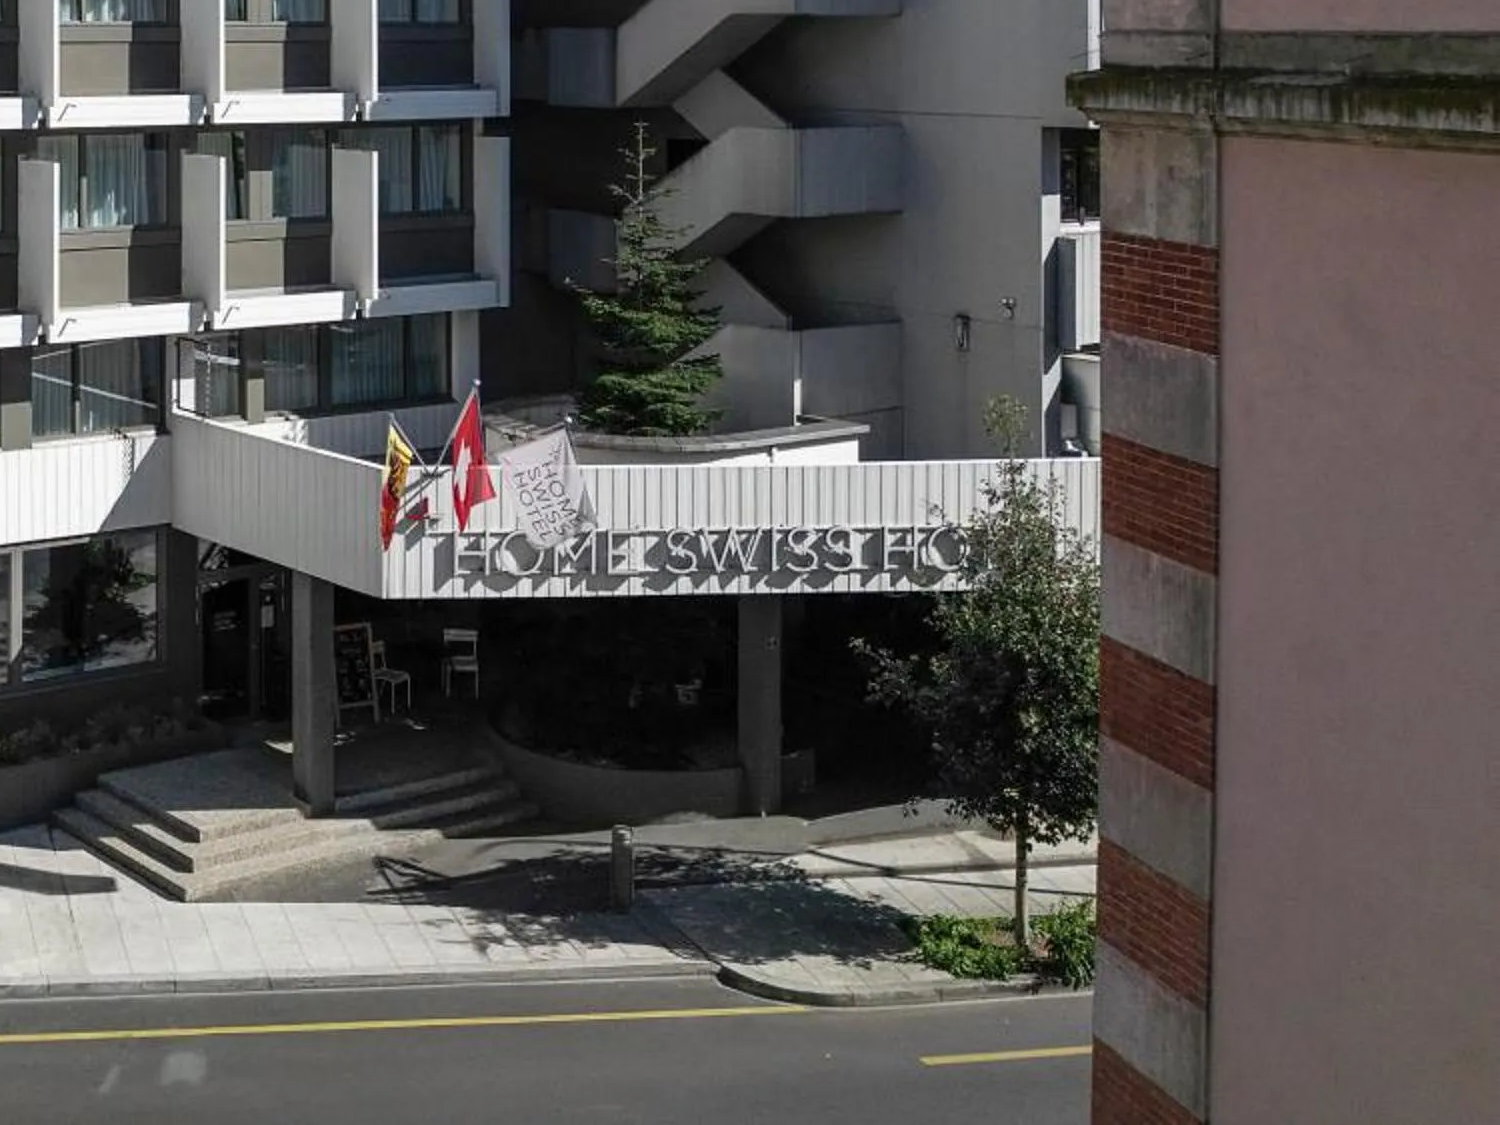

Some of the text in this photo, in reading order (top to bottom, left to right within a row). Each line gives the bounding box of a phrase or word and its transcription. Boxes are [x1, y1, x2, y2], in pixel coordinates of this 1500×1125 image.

[513, 472, 552, 541] HOTEL
[527, 467, 572, 536] SWISS
[452, 528, 646, 576] HOME
[665, 527, 853, 575] SWISS
